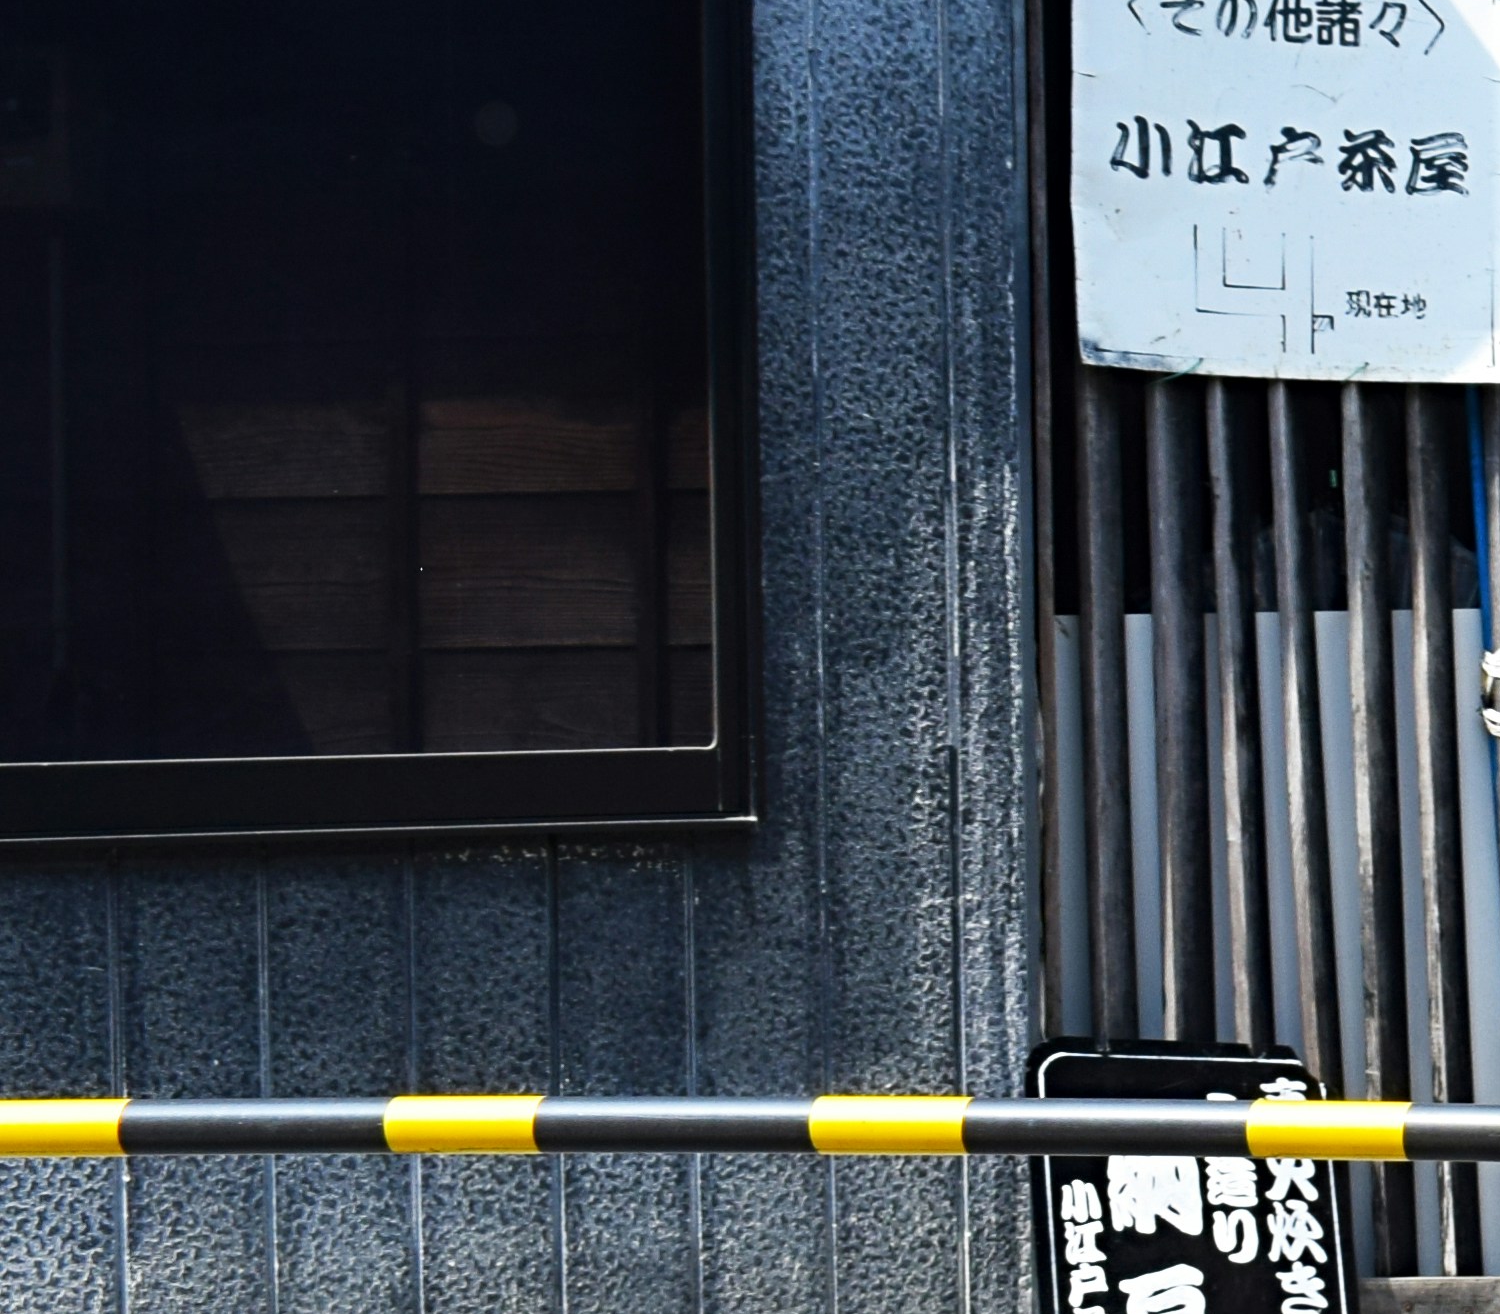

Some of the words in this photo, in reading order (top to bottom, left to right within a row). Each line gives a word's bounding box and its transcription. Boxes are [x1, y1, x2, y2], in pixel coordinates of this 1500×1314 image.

[1109, 116, 1469, 196] 小江戸茶屋
[1345, 289, 1427, 320] 現在地
[1205, 1092, 1259, 1264] 造り
